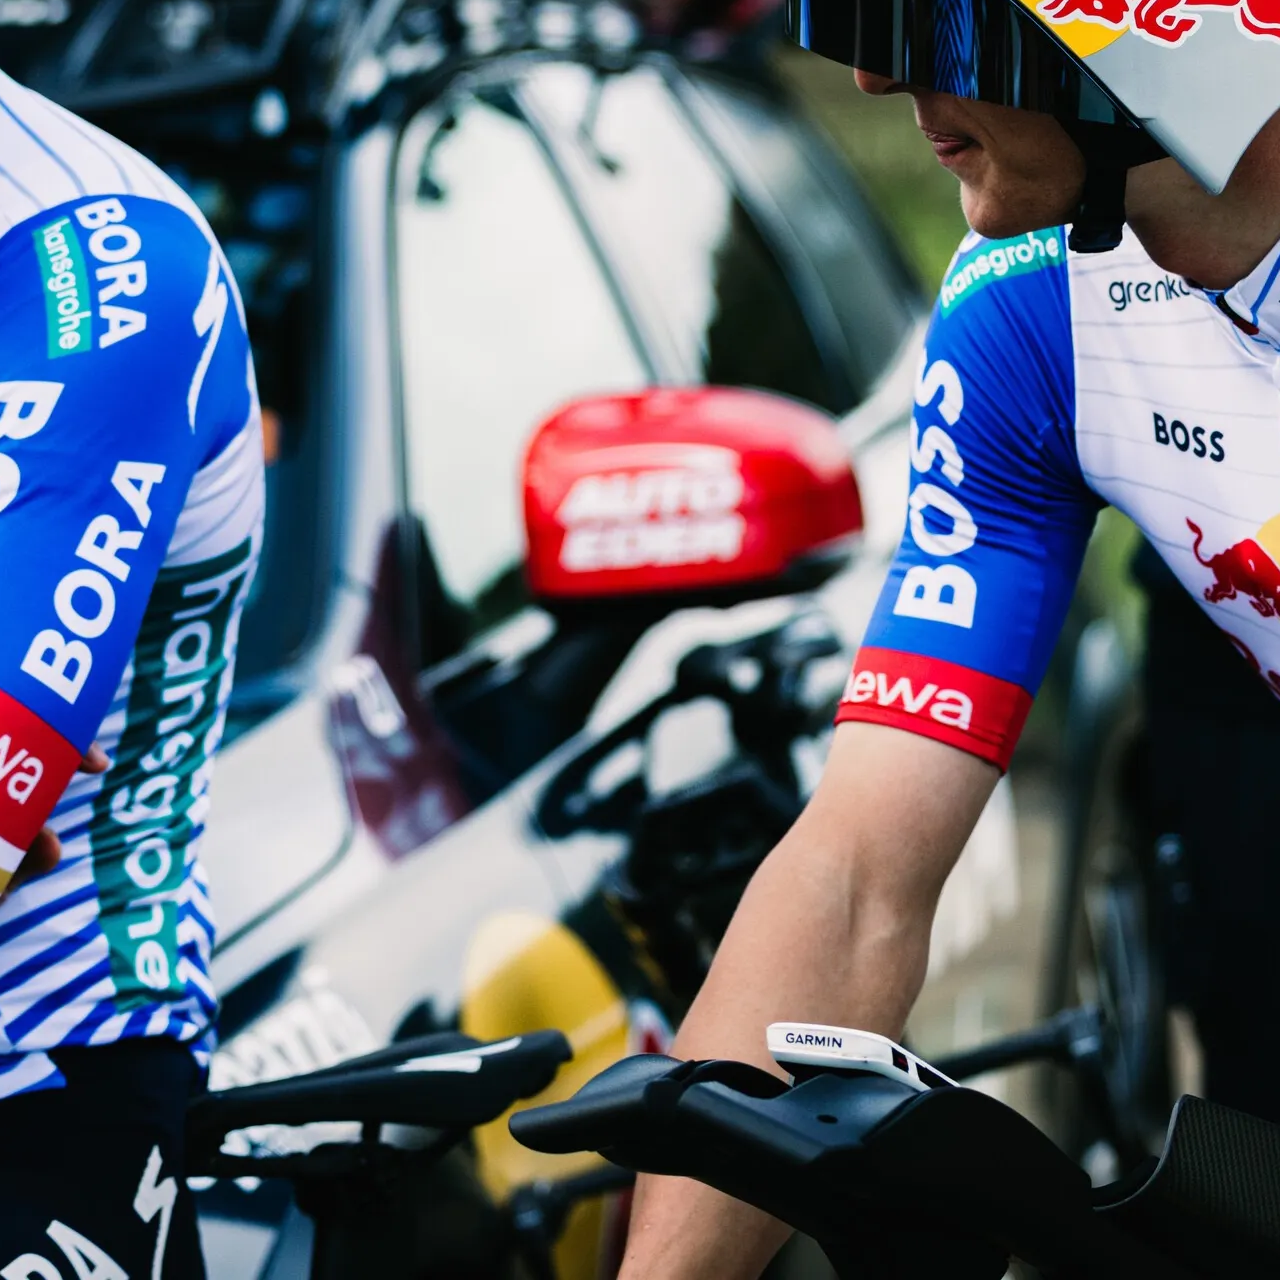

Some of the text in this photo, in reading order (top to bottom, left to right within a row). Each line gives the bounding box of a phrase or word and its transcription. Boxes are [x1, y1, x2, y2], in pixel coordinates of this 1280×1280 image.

[42, 219, 92, 351] hansgrohe
[74, 198, 147, 349] BORA
[941, 231, 1059, 308] hansgrohe
[893, 347, 978, 630] BOSS
[1152, 411, 1226, 463] BOSS
[556, 468, 744, 522] AUTO
[20, 460, 167, 705] BORA
[785, 1032, 843, 1049] GARMIN
